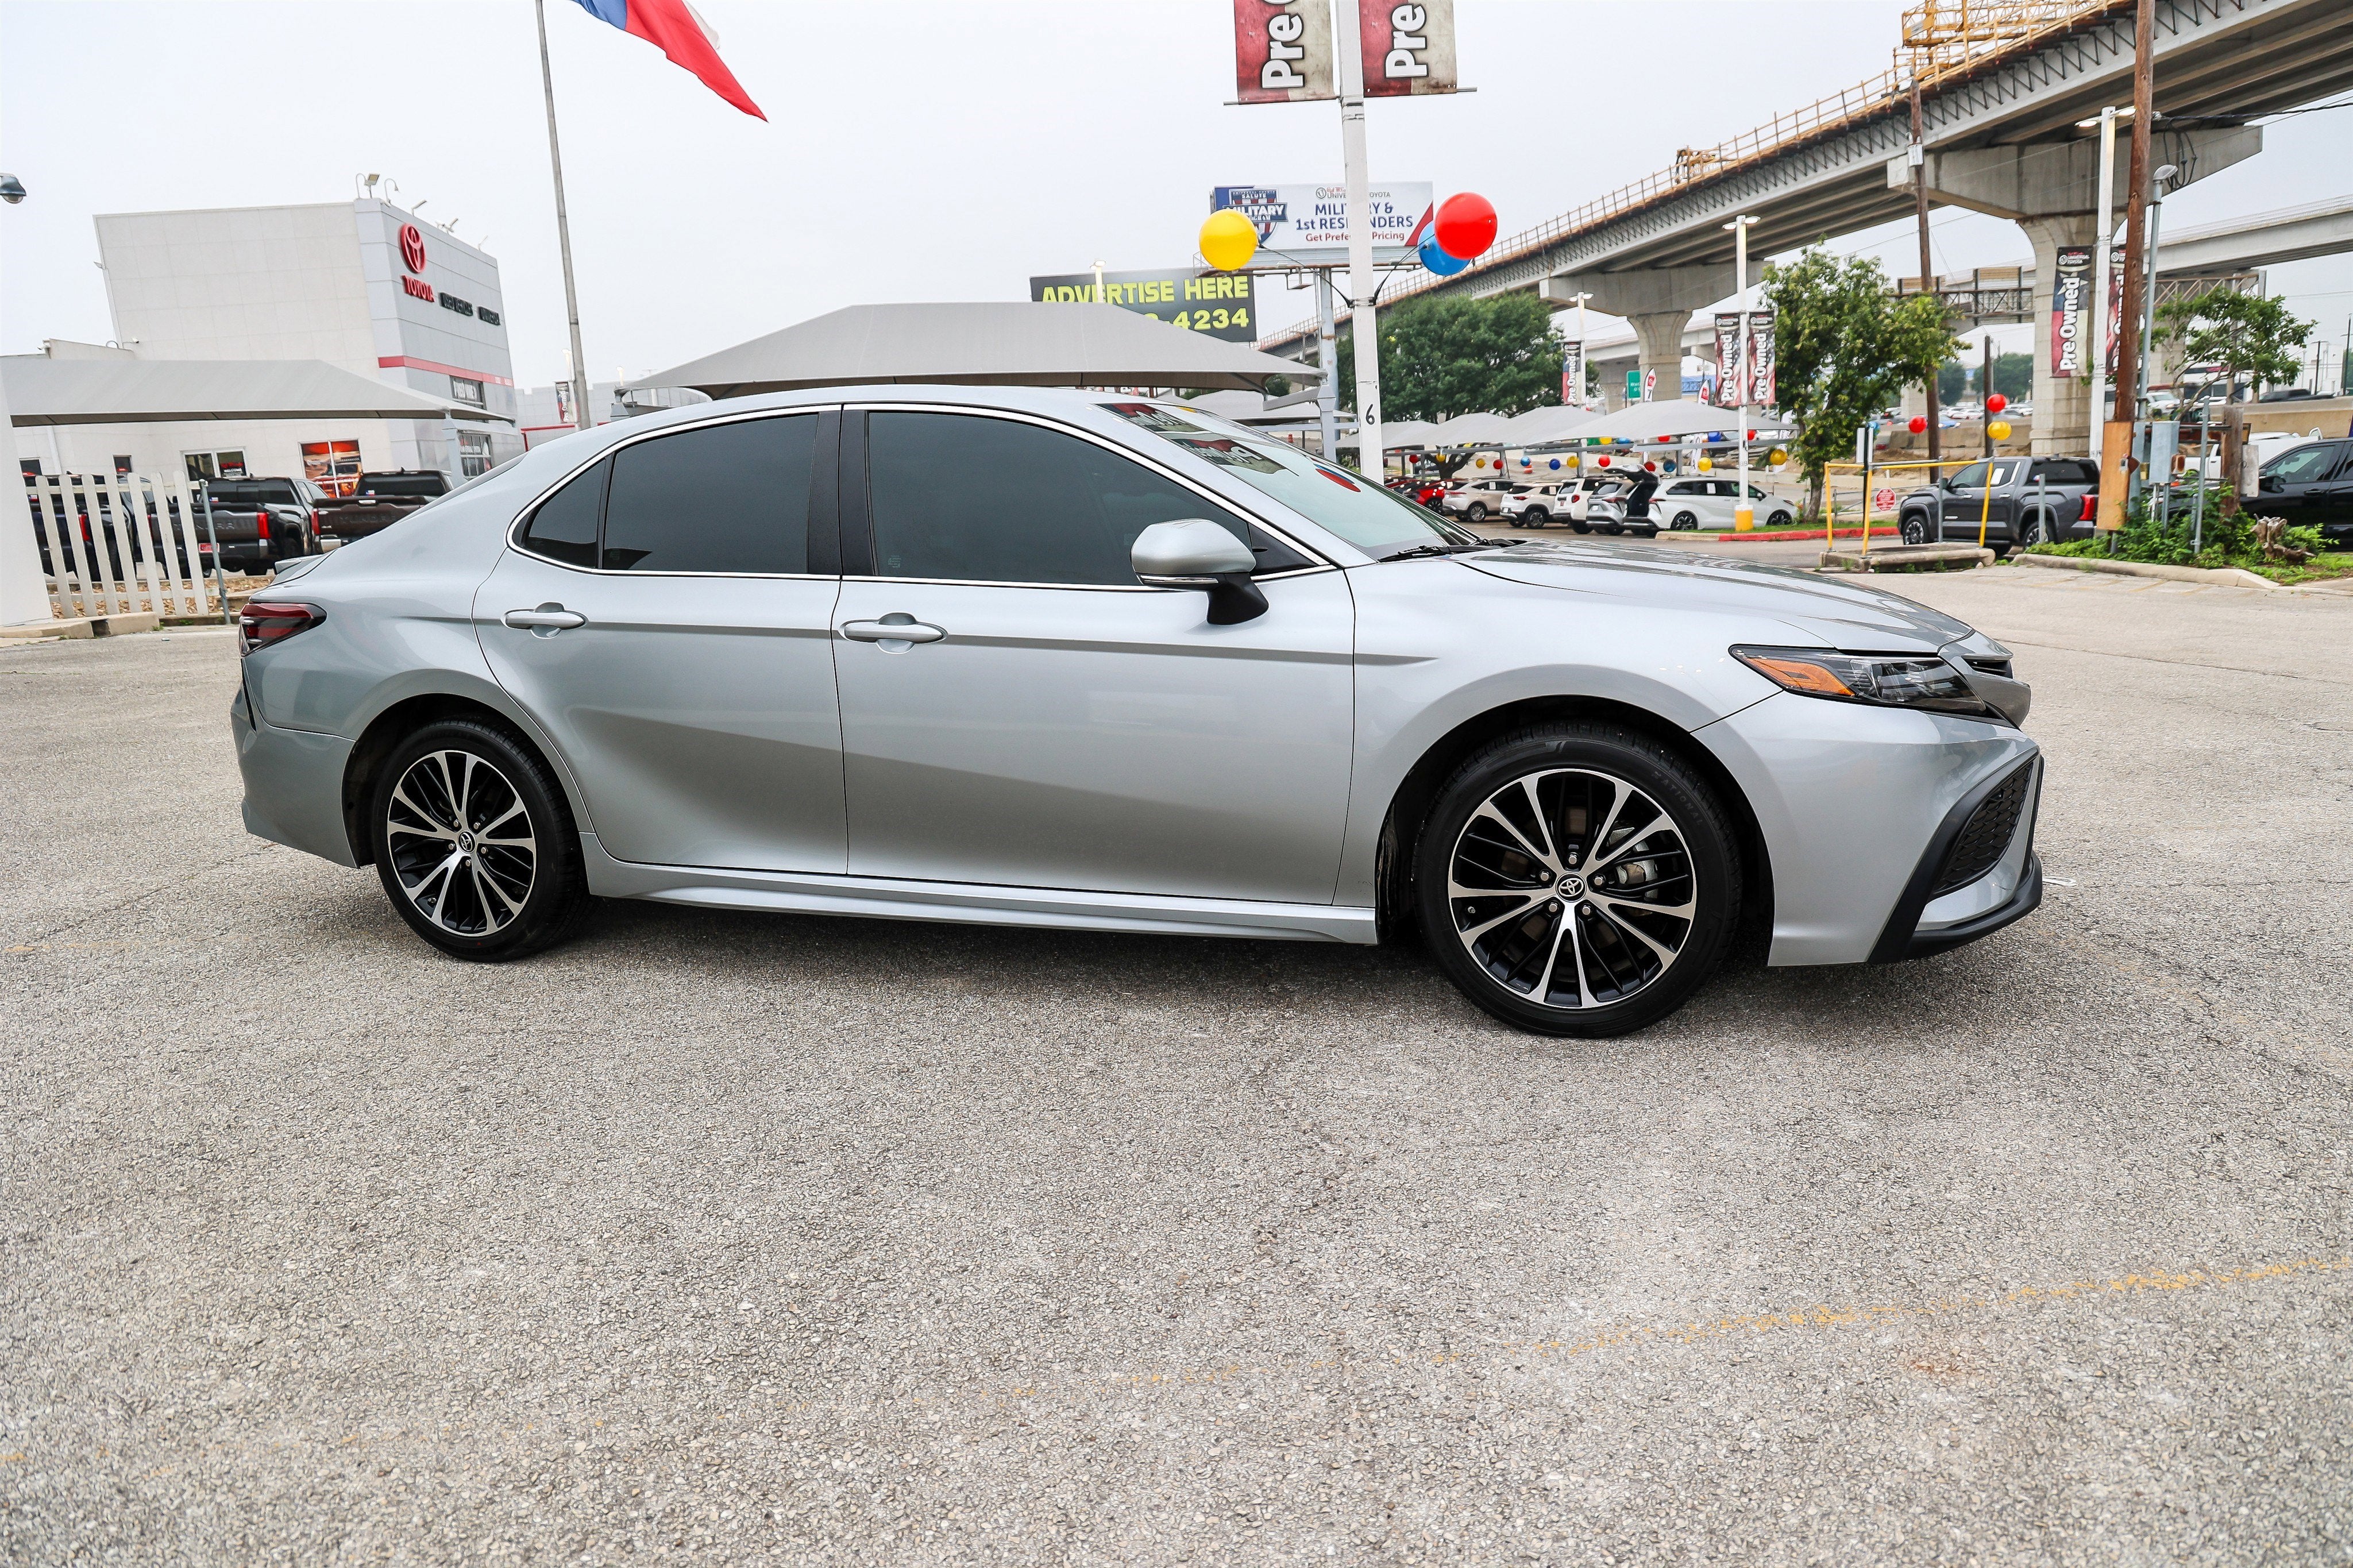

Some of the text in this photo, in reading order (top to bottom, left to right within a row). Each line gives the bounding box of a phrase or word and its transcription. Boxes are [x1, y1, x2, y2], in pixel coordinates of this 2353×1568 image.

[1262, 14, 1303, 89] Pre
[1386, 4, 1428, 78] Pre
[1384, 201, 1394, 214] &
[1296, 215, 1413, 230] 1st RESNDERS
[1306, 232, 1322, 241] Get
[1372, 231, 1405, 241] Pricing
[1184, 276, 1249, 301] HERE
[2059, 276, 2080, 339] Owned
[2059, 341, 2077, 370] Pre
[1365, 403, 1375, 424] 6
